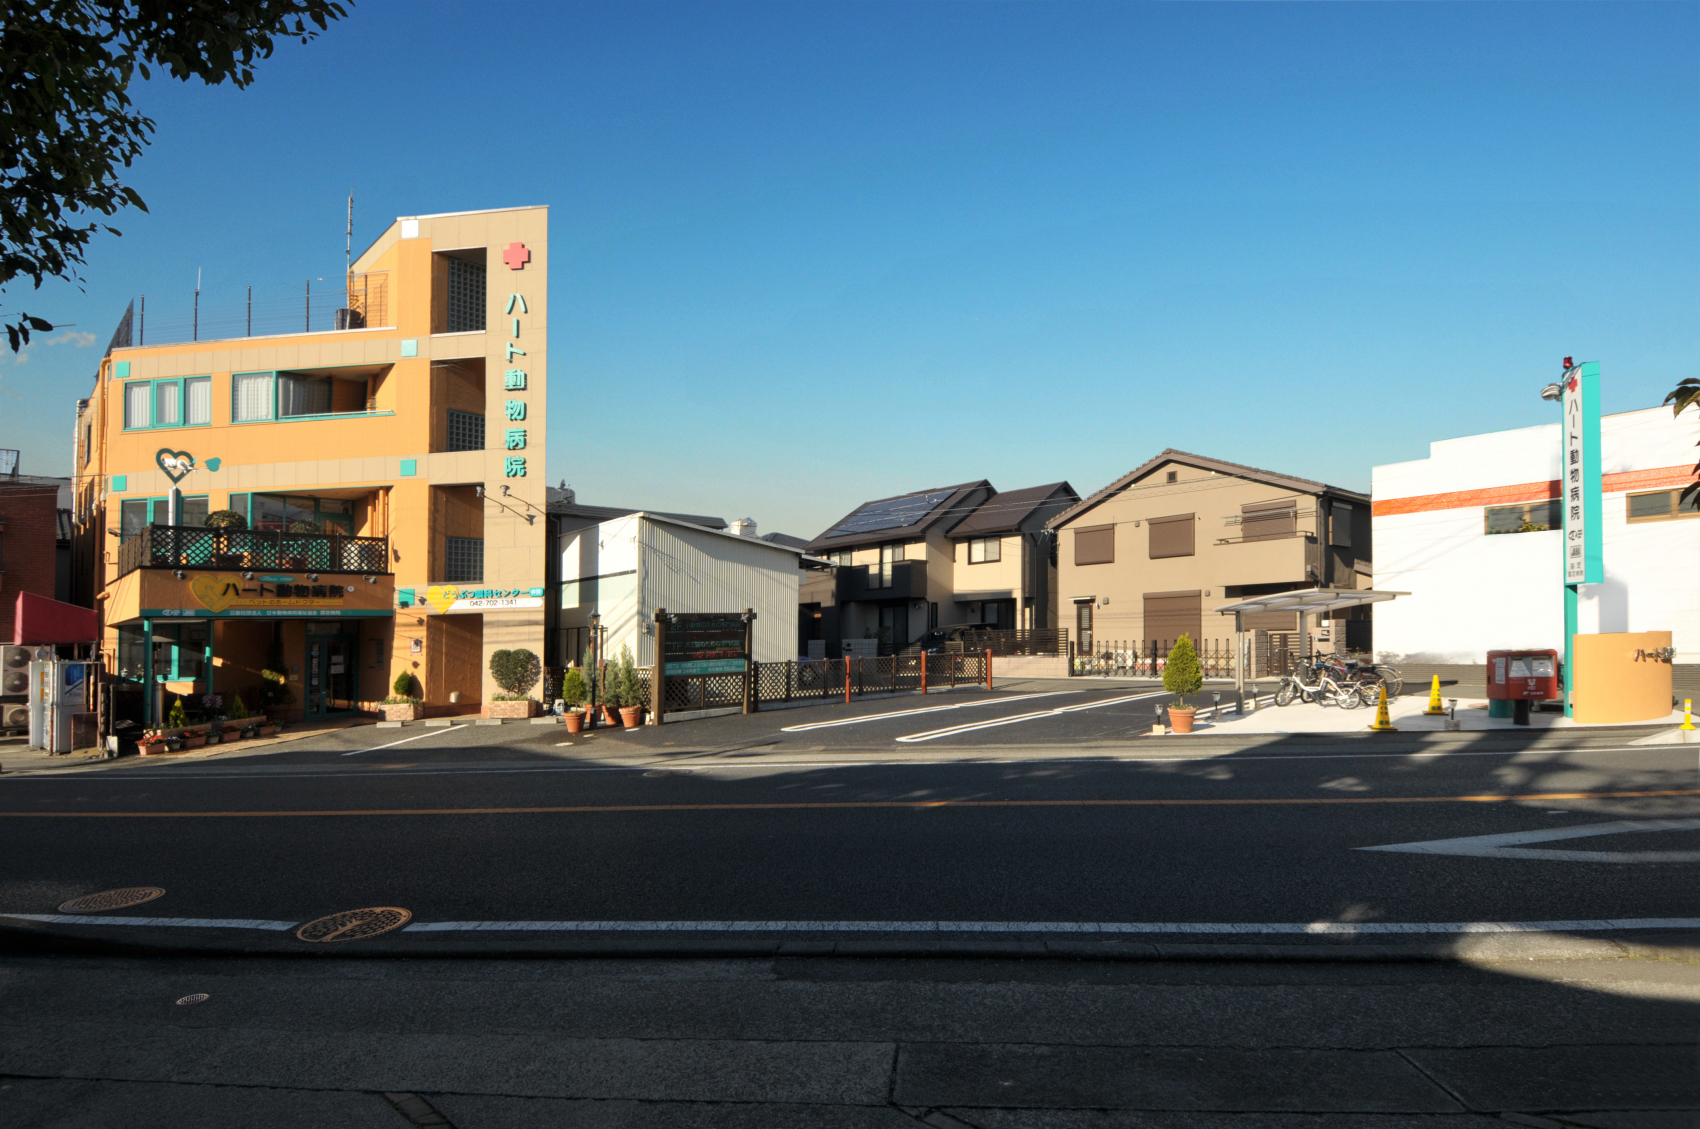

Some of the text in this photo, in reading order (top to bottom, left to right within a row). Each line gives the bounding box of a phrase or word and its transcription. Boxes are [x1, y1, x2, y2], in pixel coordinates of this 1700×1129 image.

[505, 293, 527, 478] ハート動物病院
[1569, 399, 1580, 521] ハート動物病院
[223, 583, 344, 598] ハート動物病院
[442, 589, 529, 599] どうぶつ眼科センター
[470, 599, 516, 607] 042-702-1341
